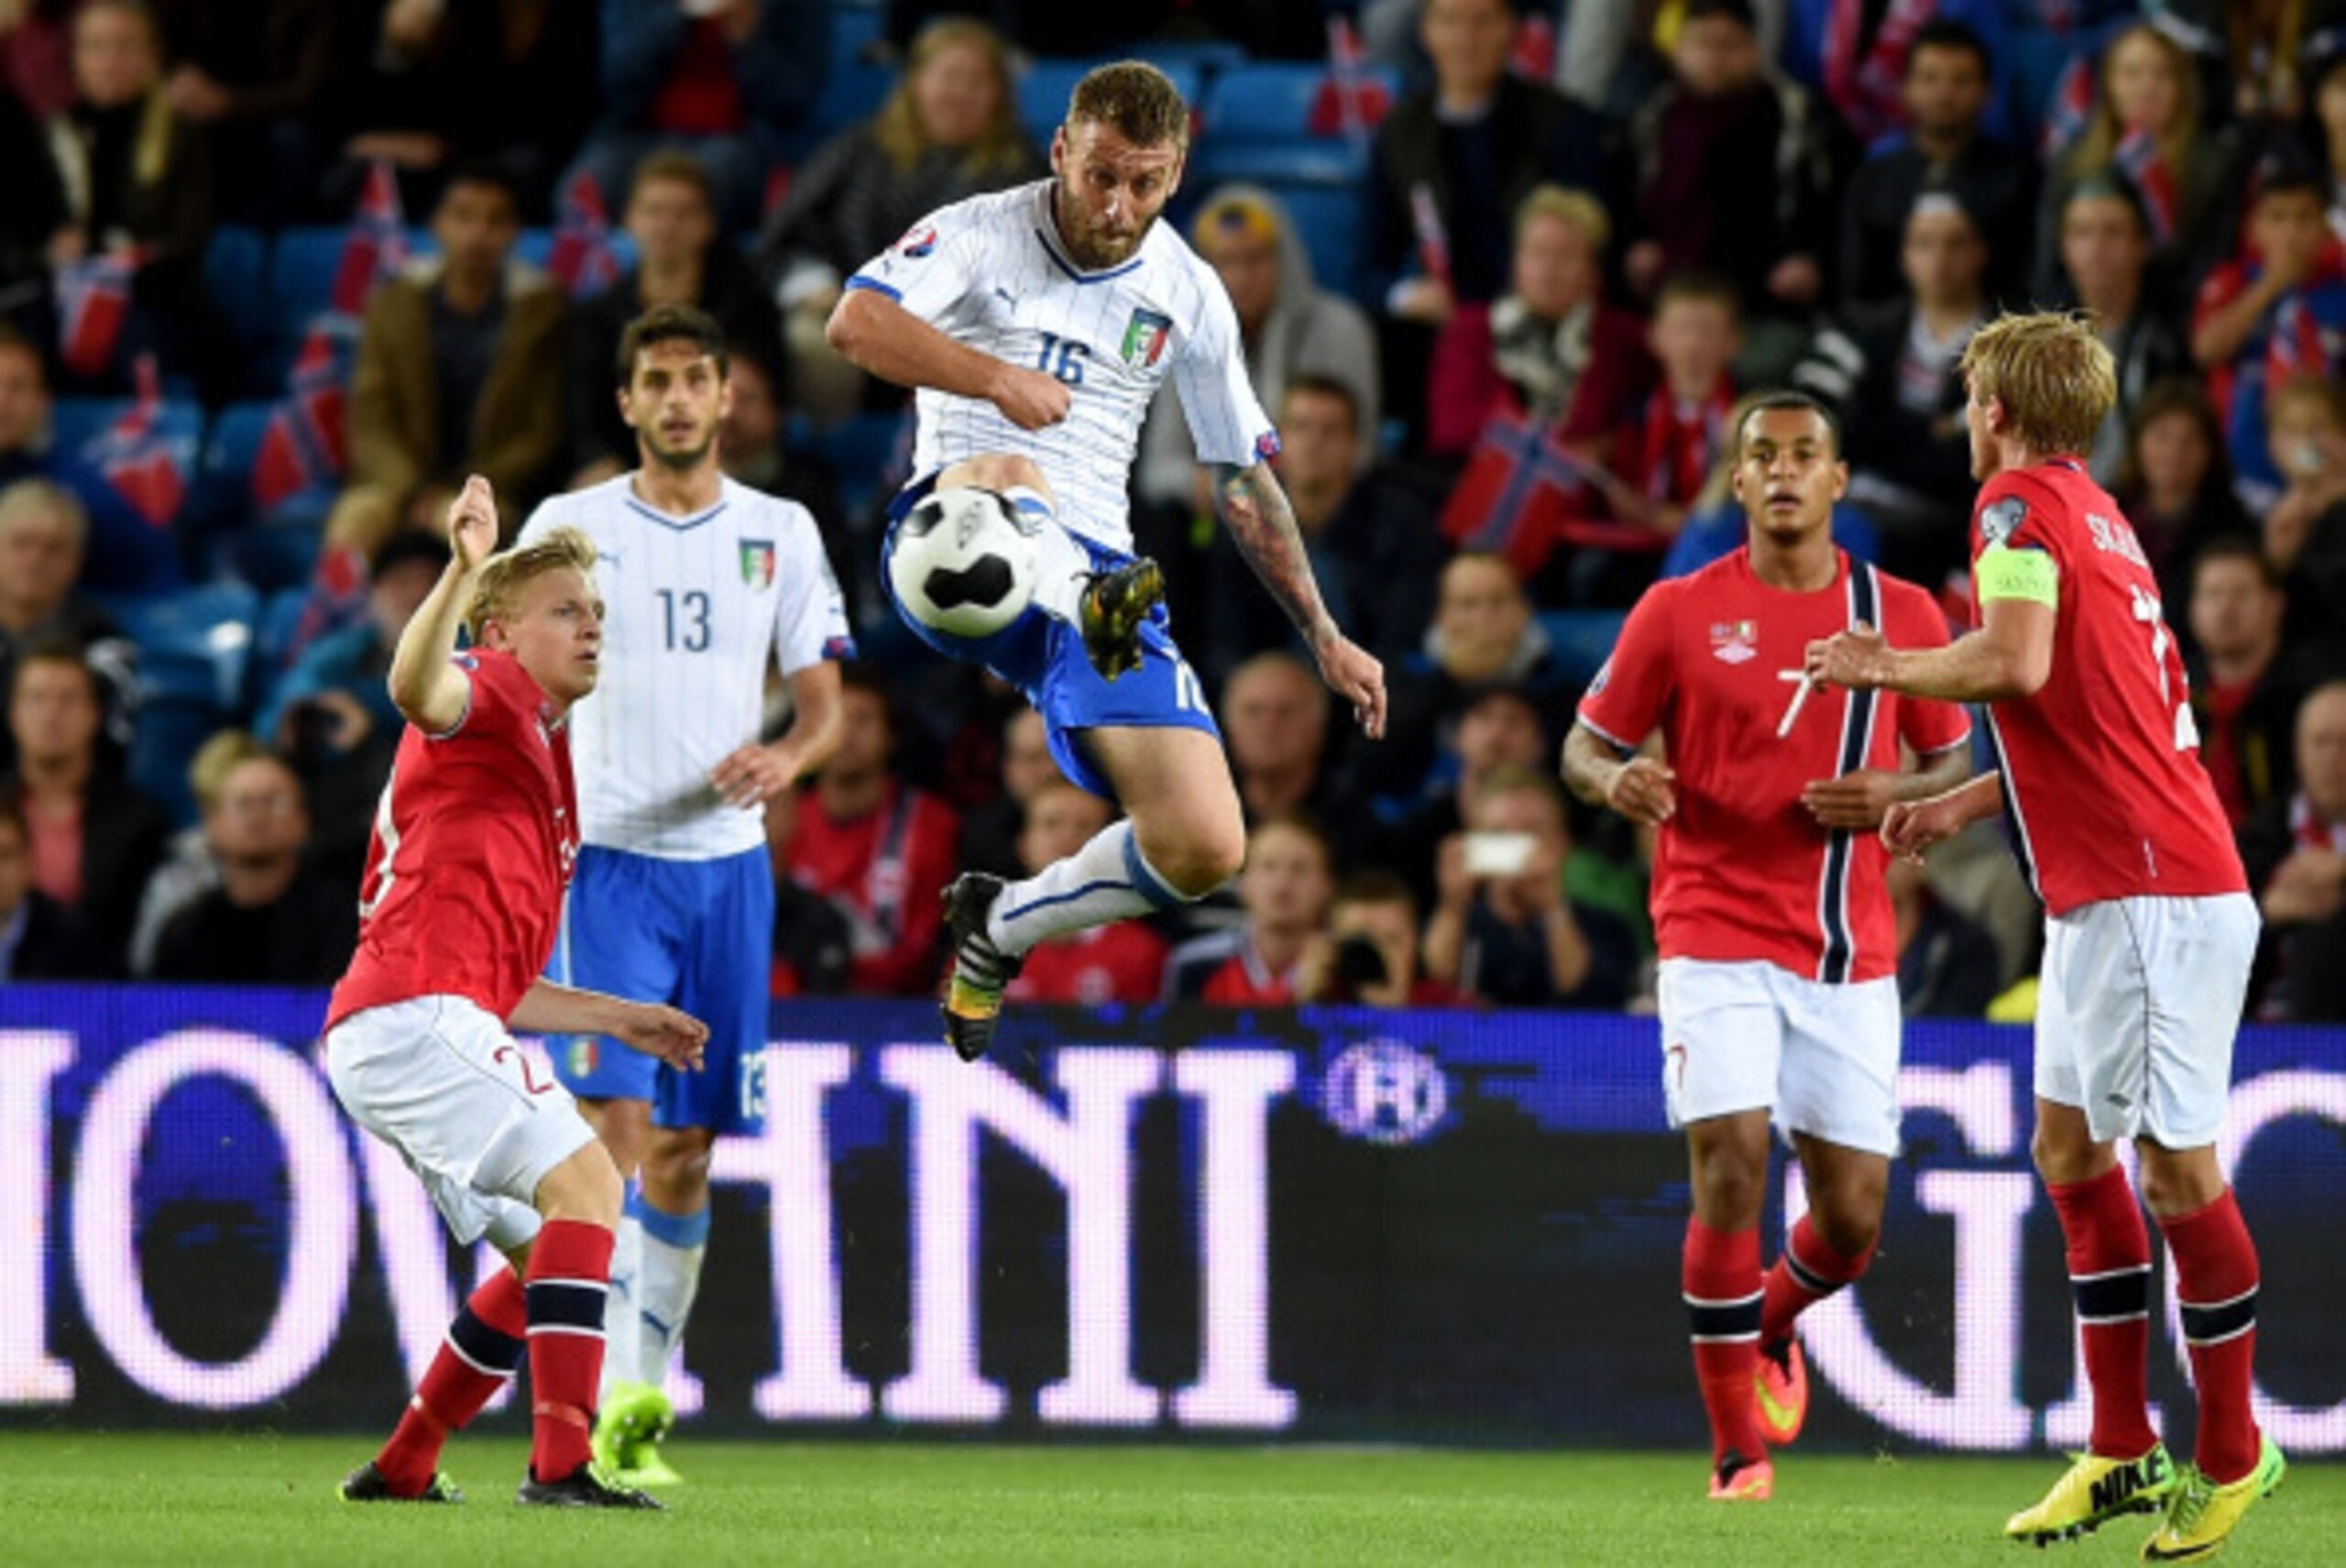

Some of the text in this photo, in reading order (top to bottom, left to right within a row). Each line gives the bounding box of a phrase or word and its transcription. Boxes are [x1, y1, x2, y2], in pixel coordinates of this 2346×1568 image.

[1038, 331, 1091, 384] 16
[655, 589, 711, 652] 13
[1776, 669, 1814, 739] 7
[494, 1047, 554, 1094] 2
[2089, 1449, 2165, 1512] NIKE
